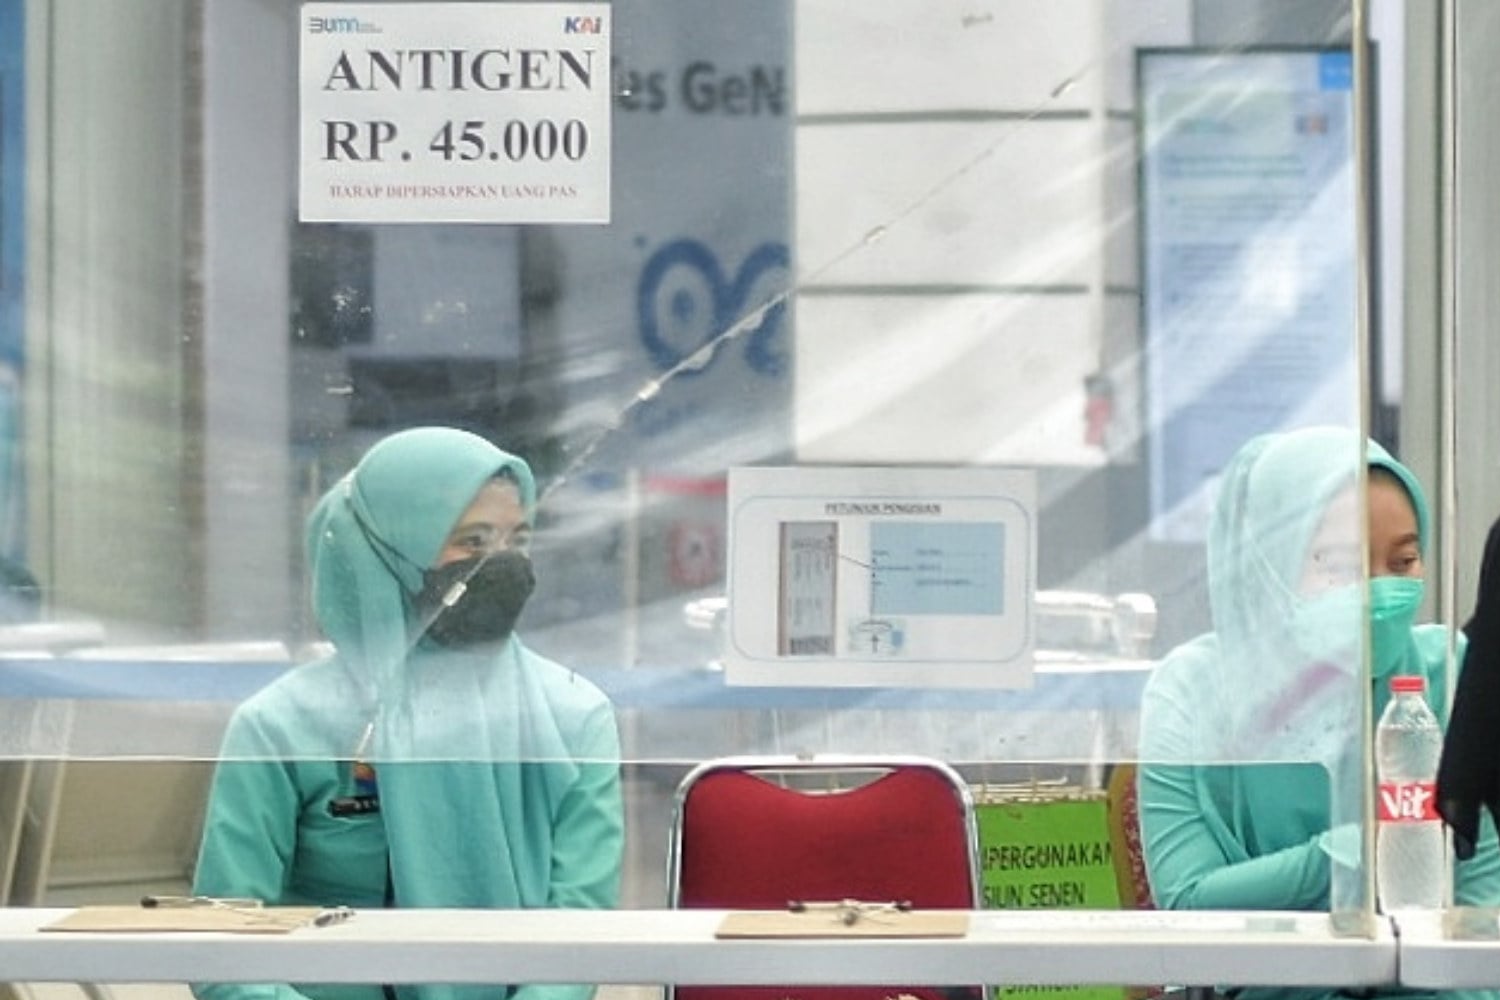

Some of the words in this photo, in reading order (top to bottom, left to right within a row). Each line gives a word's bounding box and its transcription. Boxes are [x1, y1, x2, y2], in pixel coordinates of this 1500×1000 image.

[322, 49, 596, 92] ANTIGEN
[320, 120, 412, 162] RP.
[429, 119, 588, 162] 45.000
[329, 184, 384, 198] HARAP
[1381, 784, 1433, 819] Vit
[1029, 881, 1085, 907] SENEN
